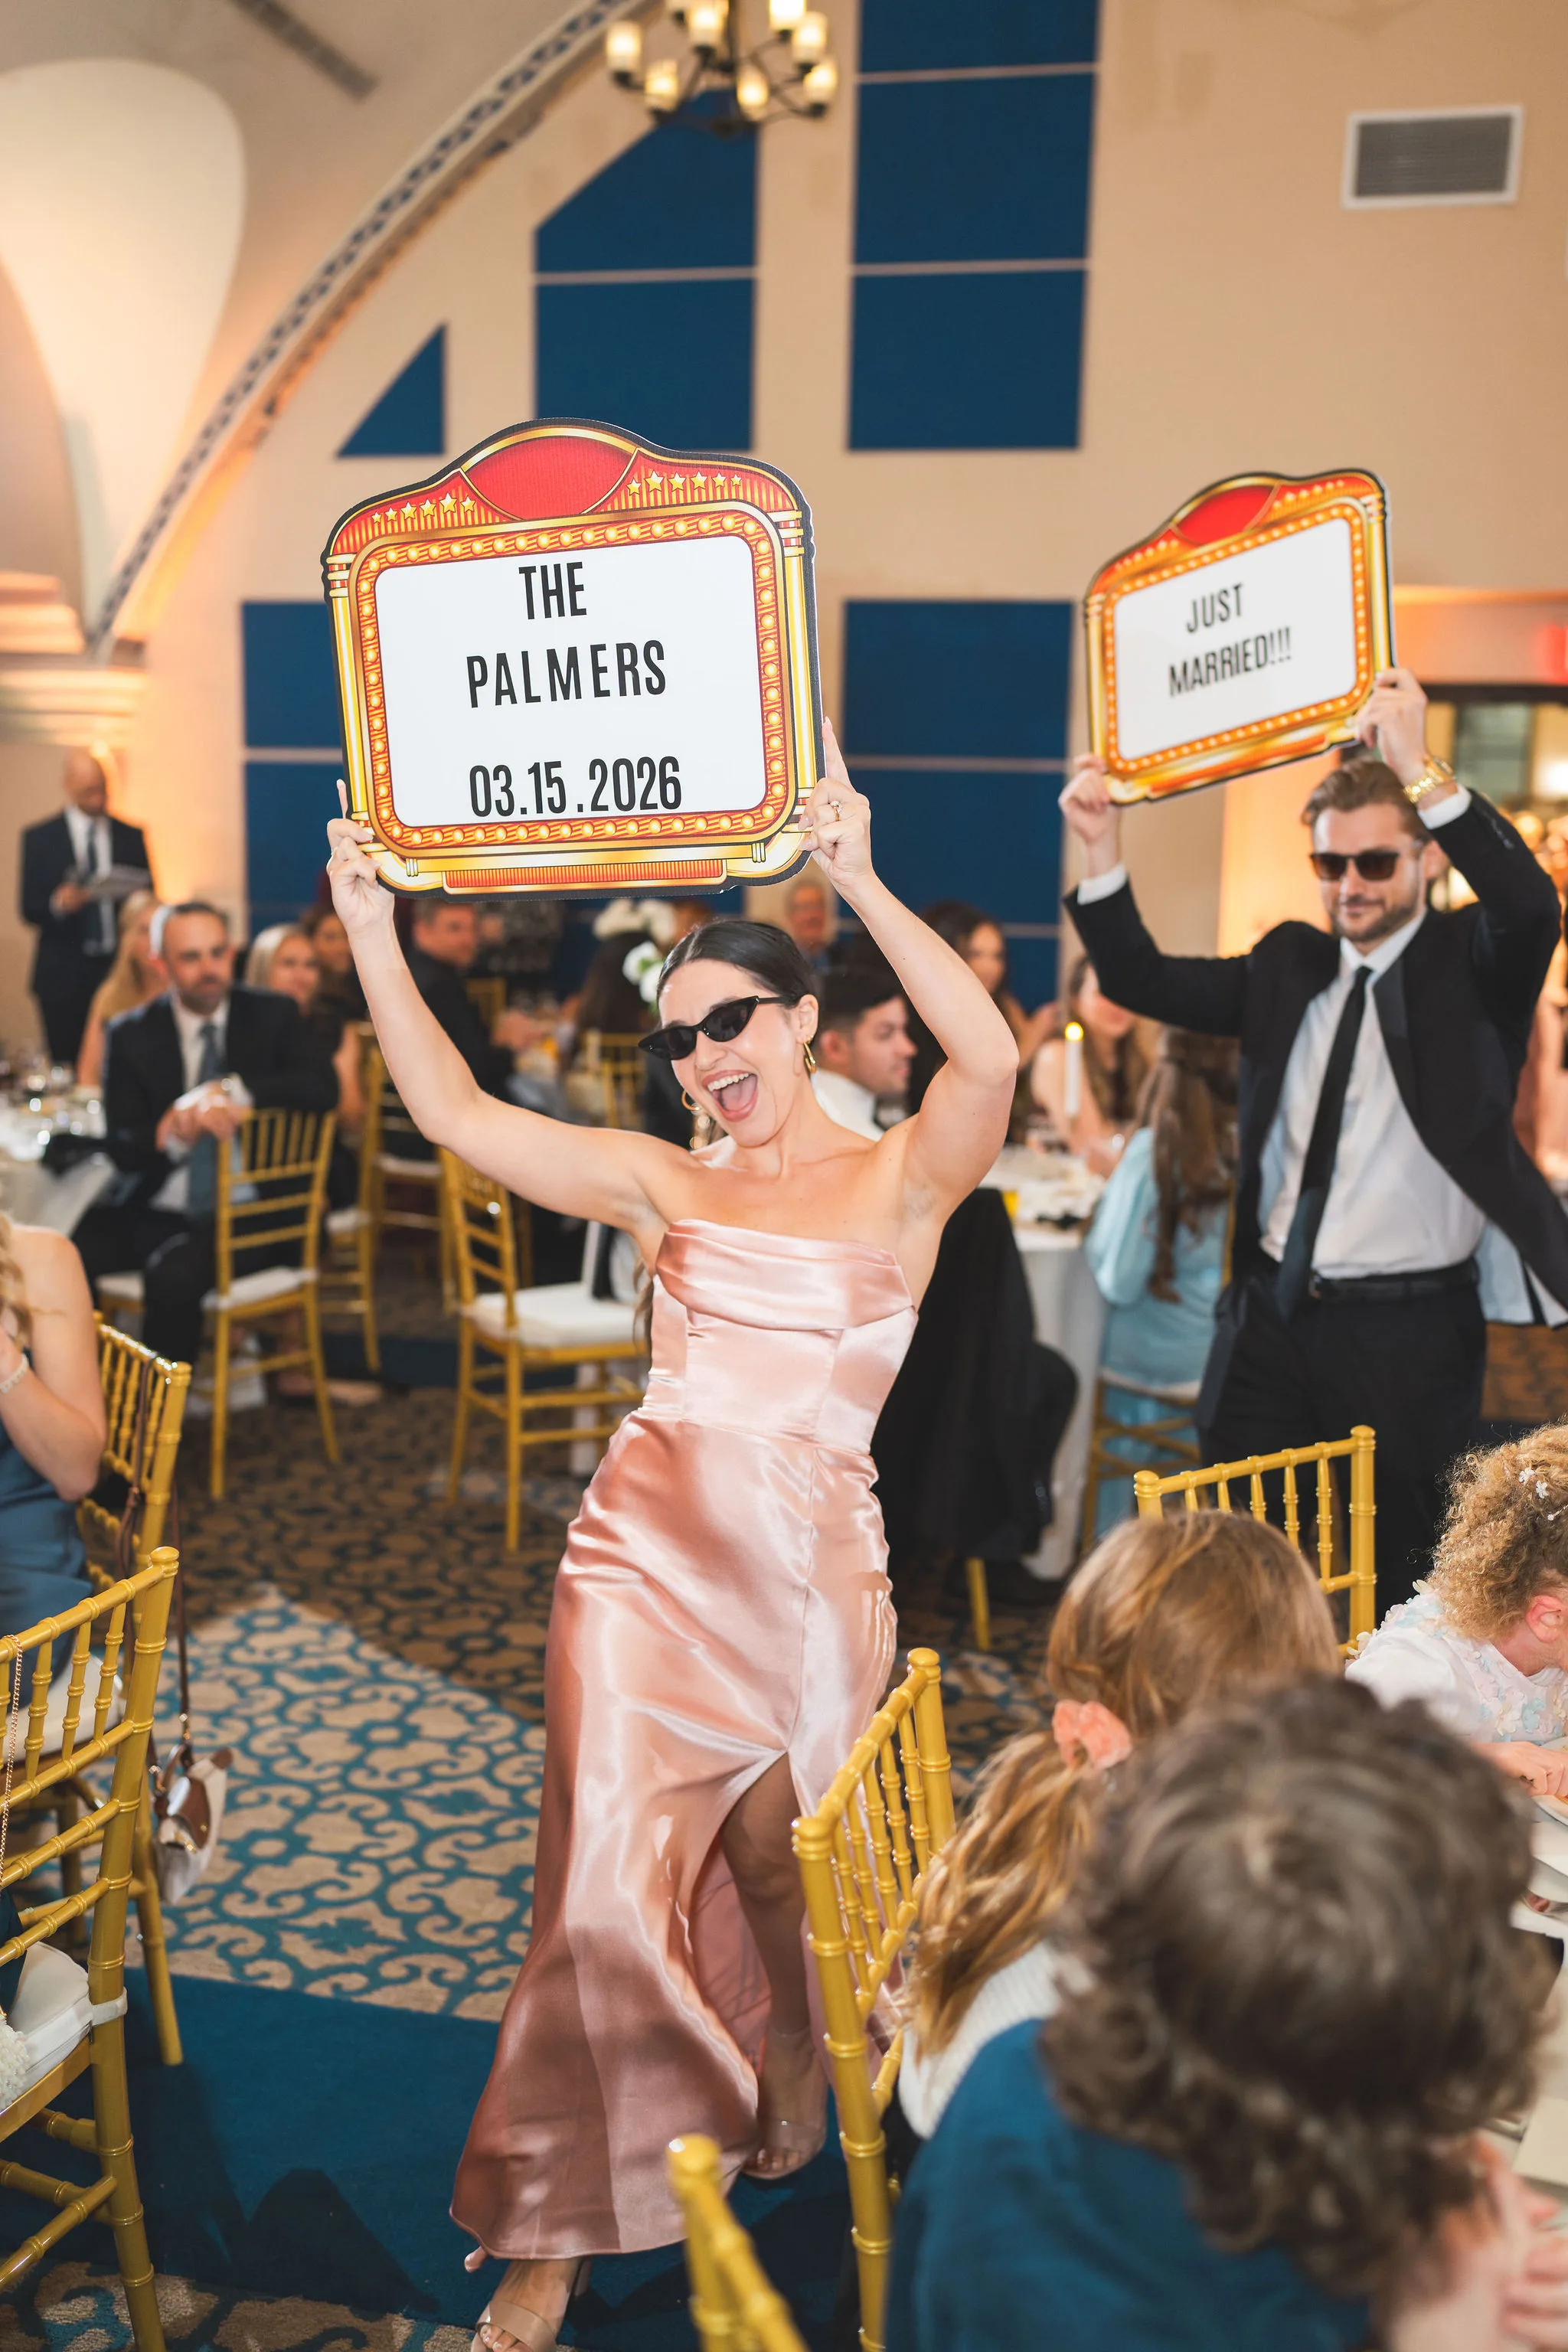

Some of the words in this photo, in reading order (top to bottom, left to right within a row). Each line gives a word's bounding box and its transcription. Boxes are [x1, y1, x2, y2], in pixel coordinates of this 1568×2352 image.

[518, 561, 586, 619] THE
[1186, 583, 1243, 633] JUST
[466, 639, 666, 708] PALMERS
[1169, 626, 1291, 697] MARRIED!!!
[469, 756, 682, 817] 03.15.2026
